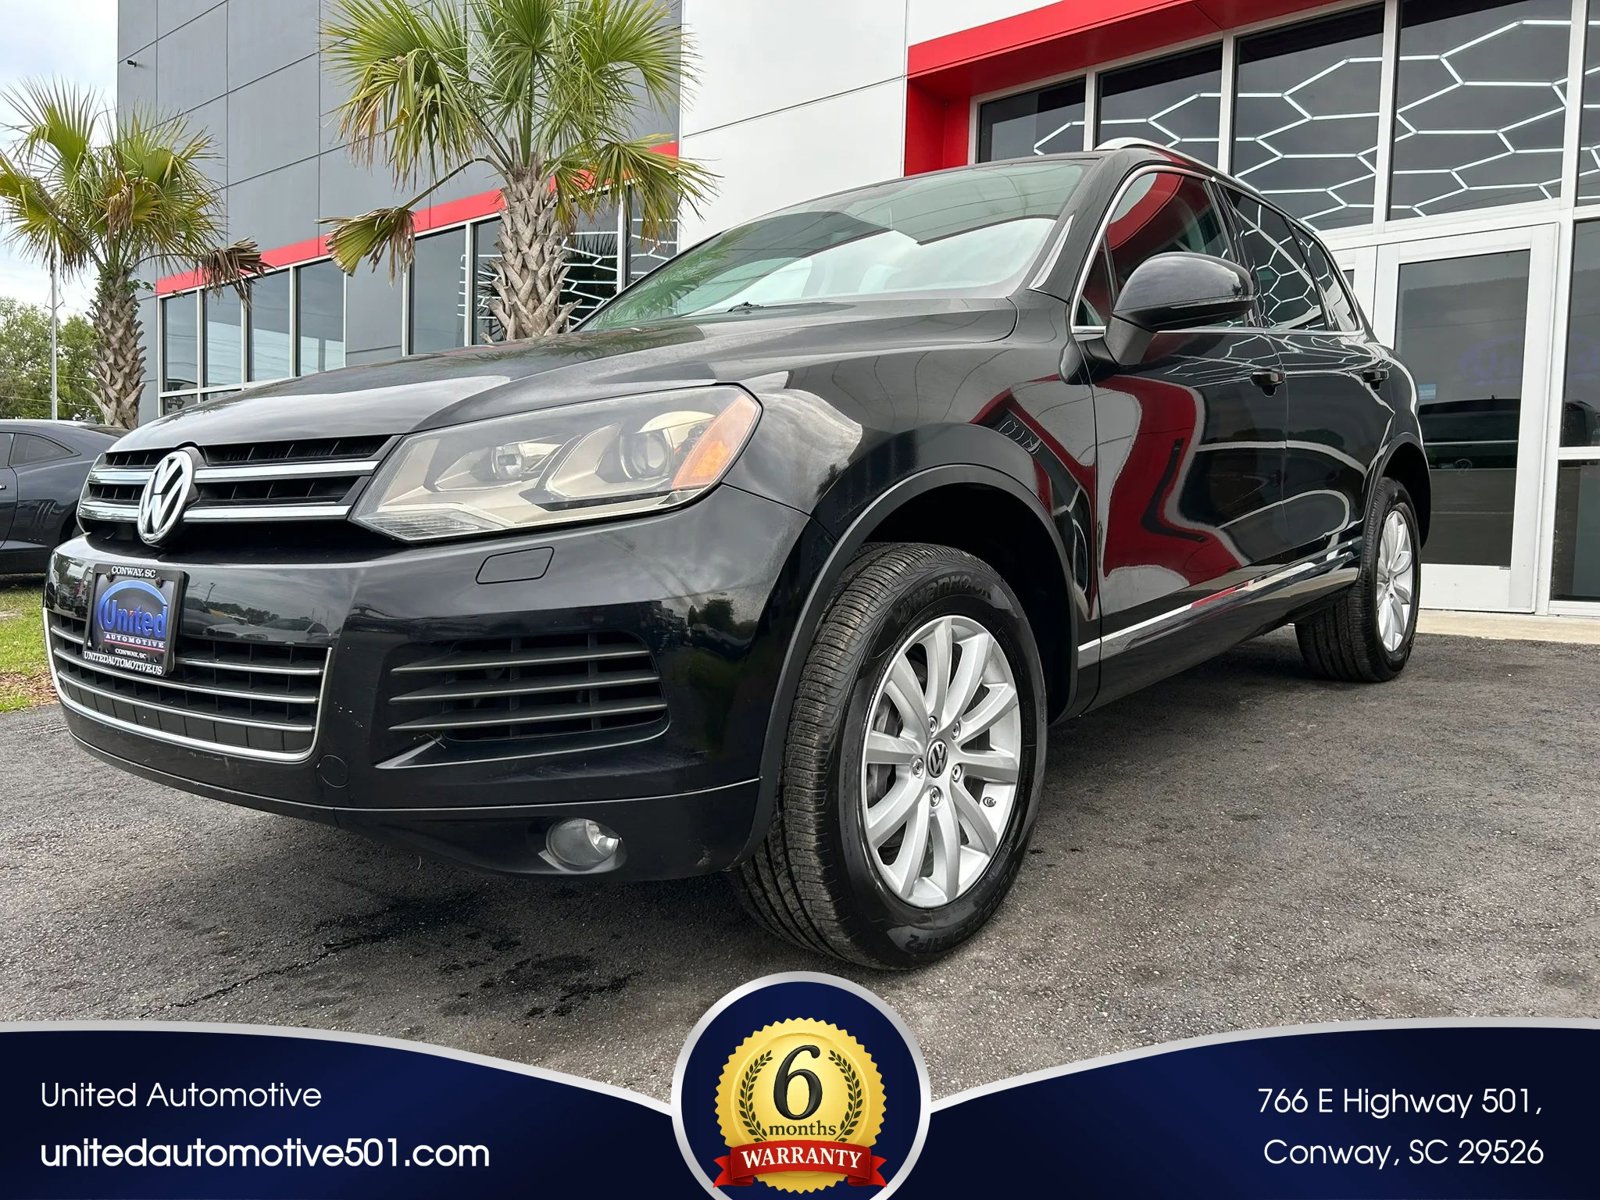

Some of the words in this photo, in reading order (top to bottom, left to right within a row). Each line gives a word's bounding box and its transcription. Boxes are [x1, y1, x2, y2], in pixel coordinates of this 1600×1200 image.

[145, 568, 156, 578] SC
[103, 599, 168, 638] United
[105, 633, 165, 649] AUTOMOTIVE
